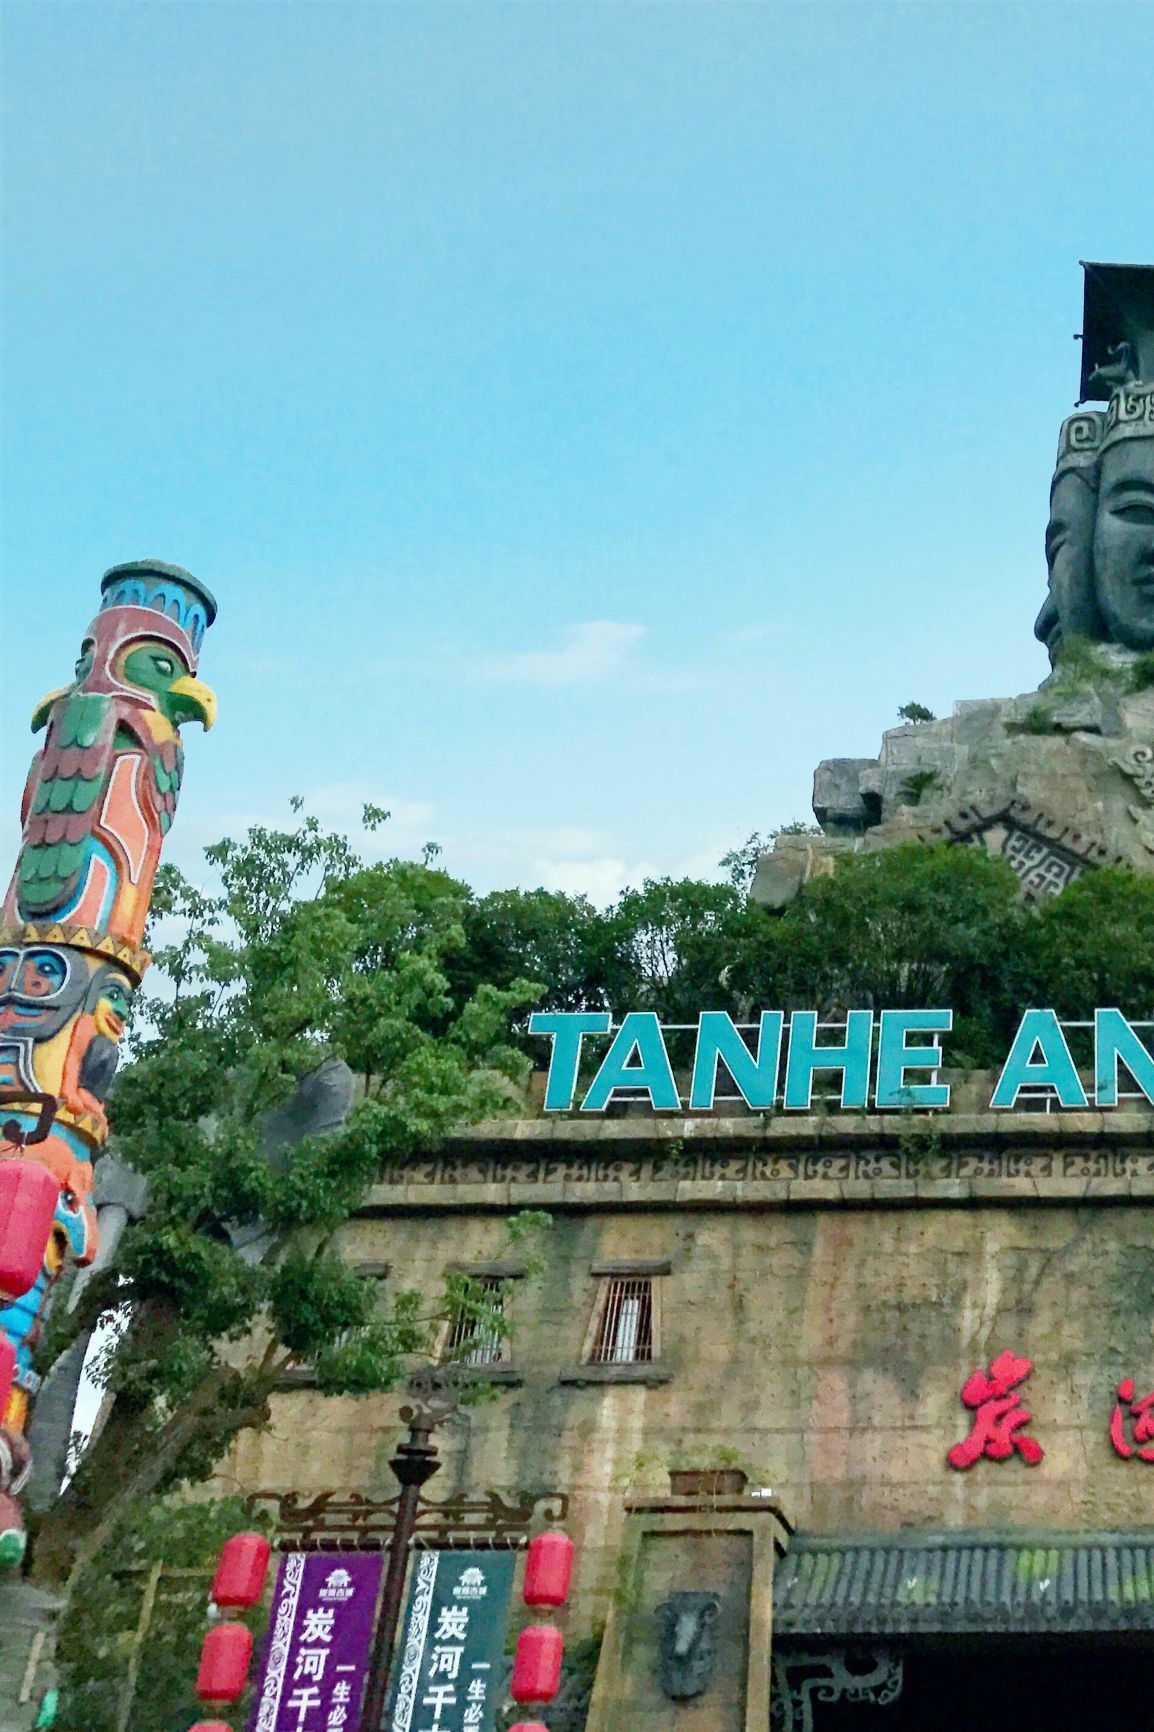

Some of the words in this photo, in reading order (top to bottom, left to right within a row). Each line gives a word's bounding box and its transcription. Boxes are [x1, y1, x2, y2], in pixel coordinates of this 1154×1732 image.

[528, 1008, 953, 1111] TANHE
[285, 1606, 336, 1732] 炭河千
[326, 1664, 356, 1732] 一生必
[418, 1605, 470, 1732] 炭河千
[462, 1662, 491, 1732] 一生必
